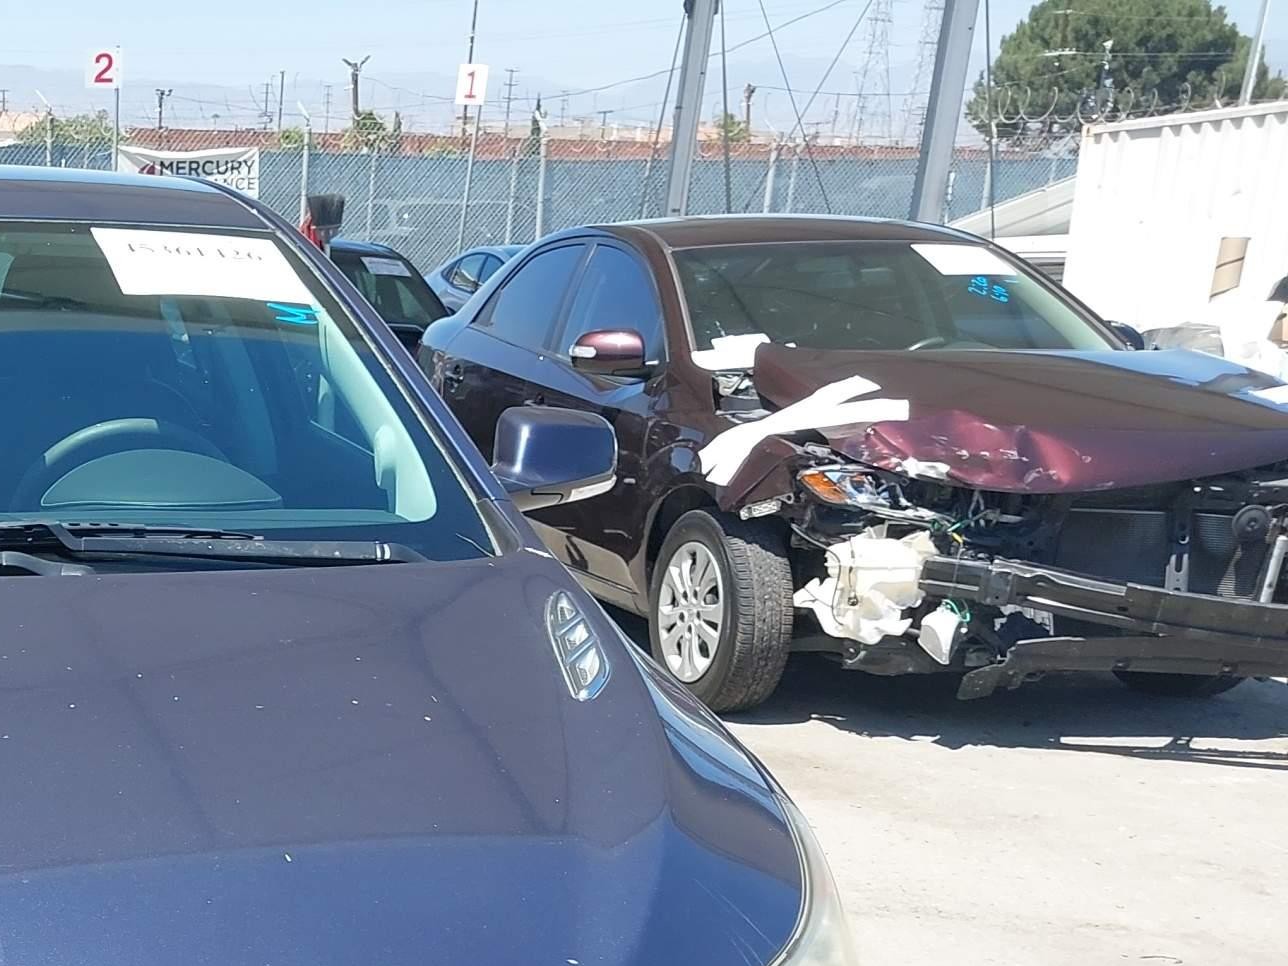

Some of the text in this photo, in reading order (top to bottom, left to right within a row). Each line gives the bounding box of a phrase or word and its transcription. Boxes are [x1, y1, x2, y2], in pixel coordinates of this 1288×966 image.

[94, 52, 113, 83] 2
[464, 70, 477, 98] 1
[159, 159, 256, 177] MERCURY
